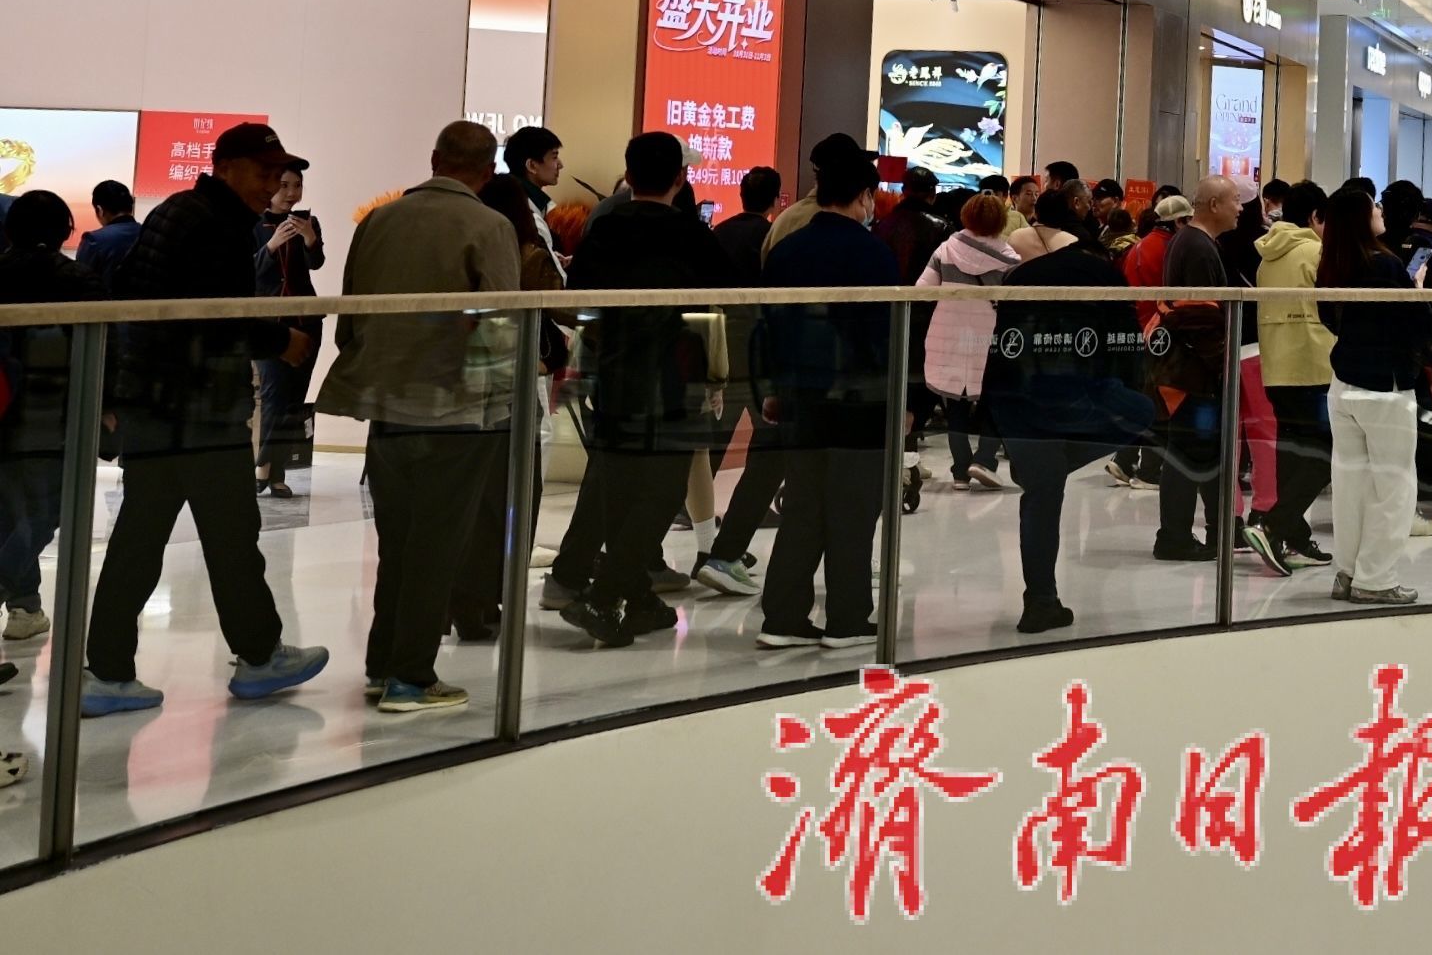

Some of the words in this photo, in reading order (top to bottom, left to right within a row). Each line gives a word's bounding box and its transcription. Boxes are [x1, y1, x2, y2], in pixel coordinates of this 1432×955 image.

[666, 99, 755, 130] 旧黄金免工费
[1215, 93, 1258, 113] Grand
